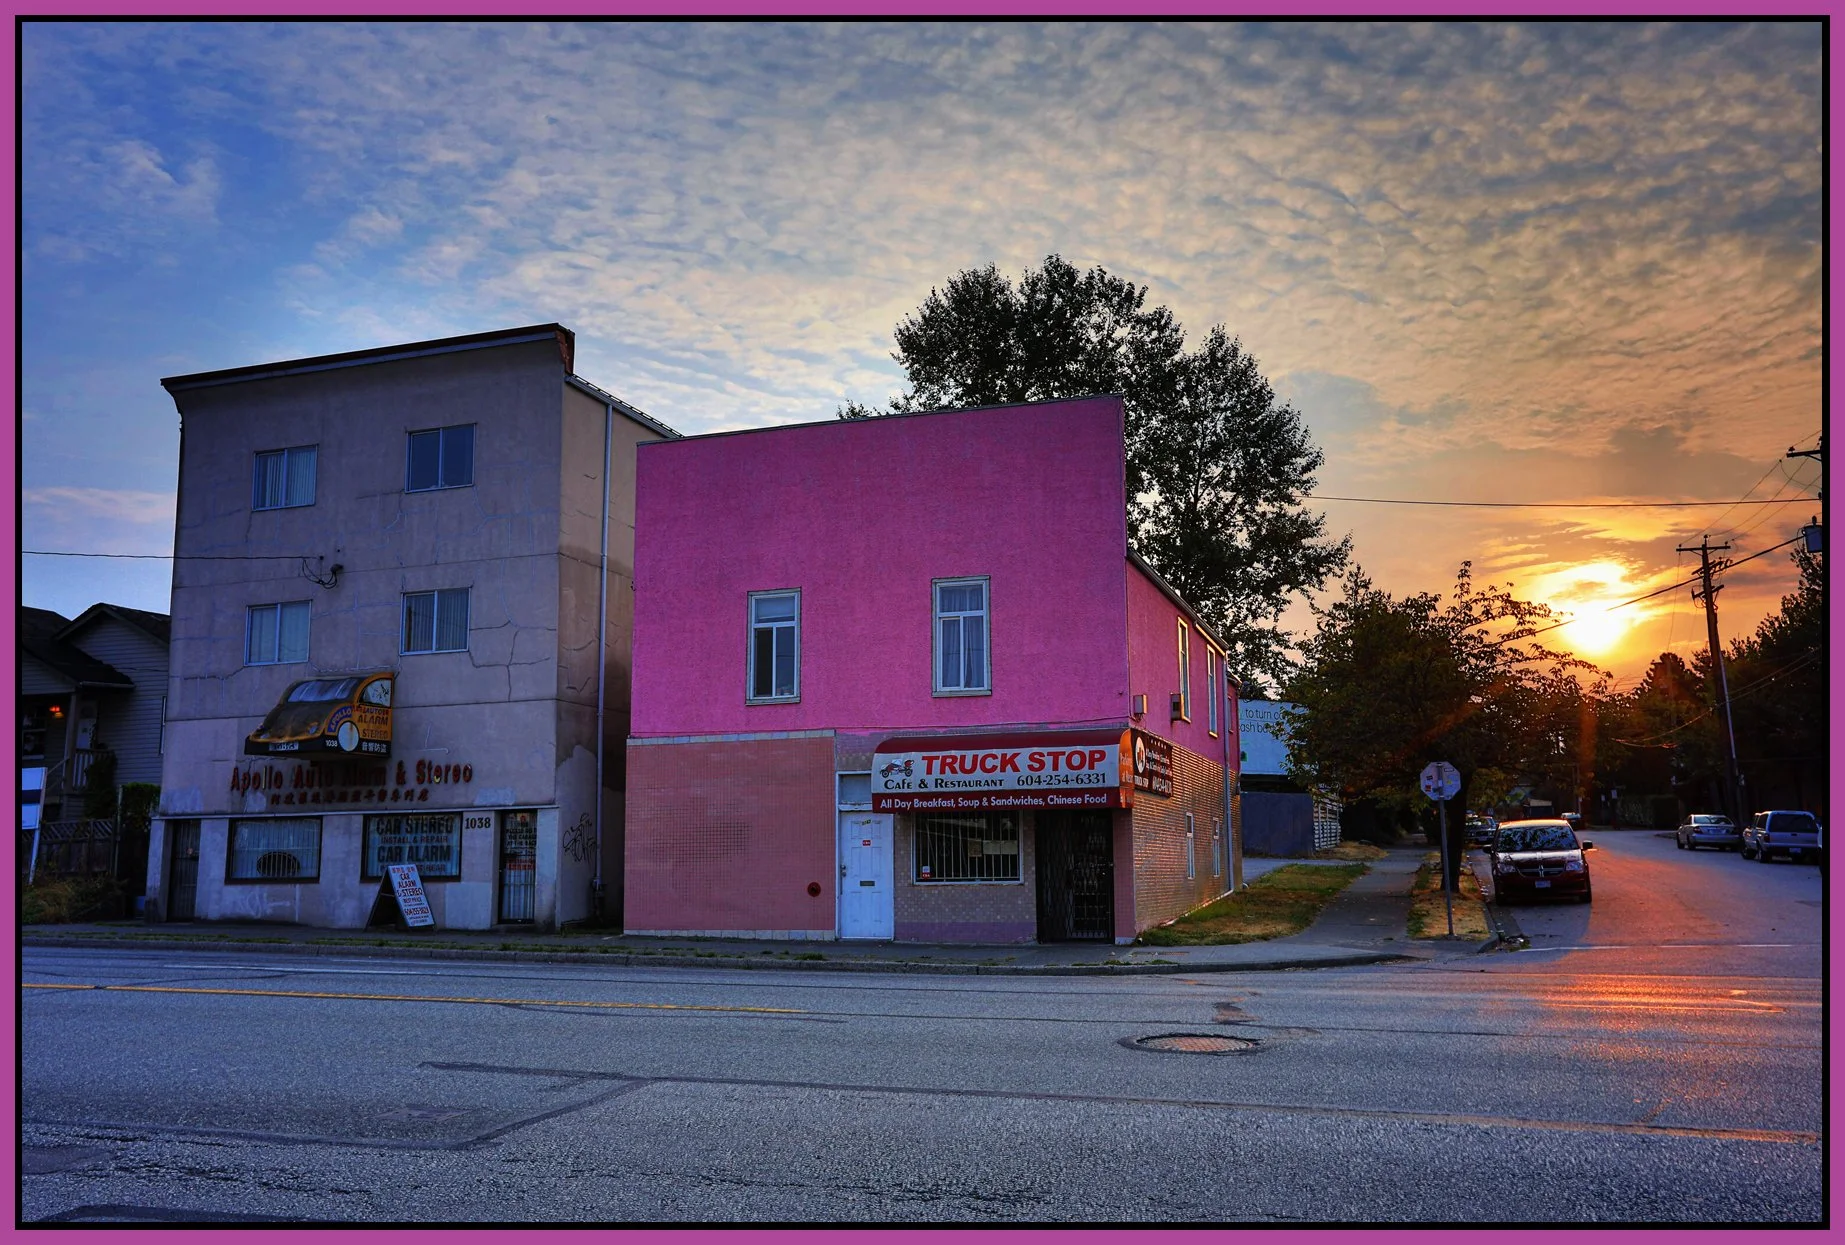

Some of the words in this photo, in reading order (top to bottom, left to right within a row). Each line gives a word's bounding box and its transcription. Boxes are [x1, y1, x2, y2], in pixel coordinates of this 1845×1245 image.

[1245, 708, 1254, 718] to
[1256, 709, 1271, 719] turn
[357, 714, 388, 726] ALARM
[1240, 722, 1255, 733] ash
[362, 728, 388, 740] STEREO
[922, 752, 1021, 775] TRUCK
[1027, 750, 1106, 772] STOP
[231, 766, 283, 796] Apollo
[293, 763, 334, 788] Auto
[396, 761, 406, 785] &
[416, 760, 473, 784] Stereo
[918, 779, 929, 789] &
[1017, 773, 1106, 786] 604-254-6331
[880, 799, 891, 809] All
[894, 799, 912, 810] Day
[914, 797, 956, 809] Breakfast,
[958, 797, 980, 809] Soup
[982, 797, 989, 807] &
[990, 795, 1046, 807] Sandwiches,
[1047, 794, 1083, 805] Chinese
[1084, 794, 1107, 804] Food
[376, 818, 401, 835] CAR
[405, 816, 453, 834] STEREO
[465, 817, 491, 829] 1038
[381, 836, 409, 844] INSTALL
[421, 835, 448, 844] REPAIR
[378, 846, 401, 862] CAR
[407, 845, 451, 862] ALARM
[398, 880, 416, 889] ALARM
[402, 888, 423, 896] STEREO
